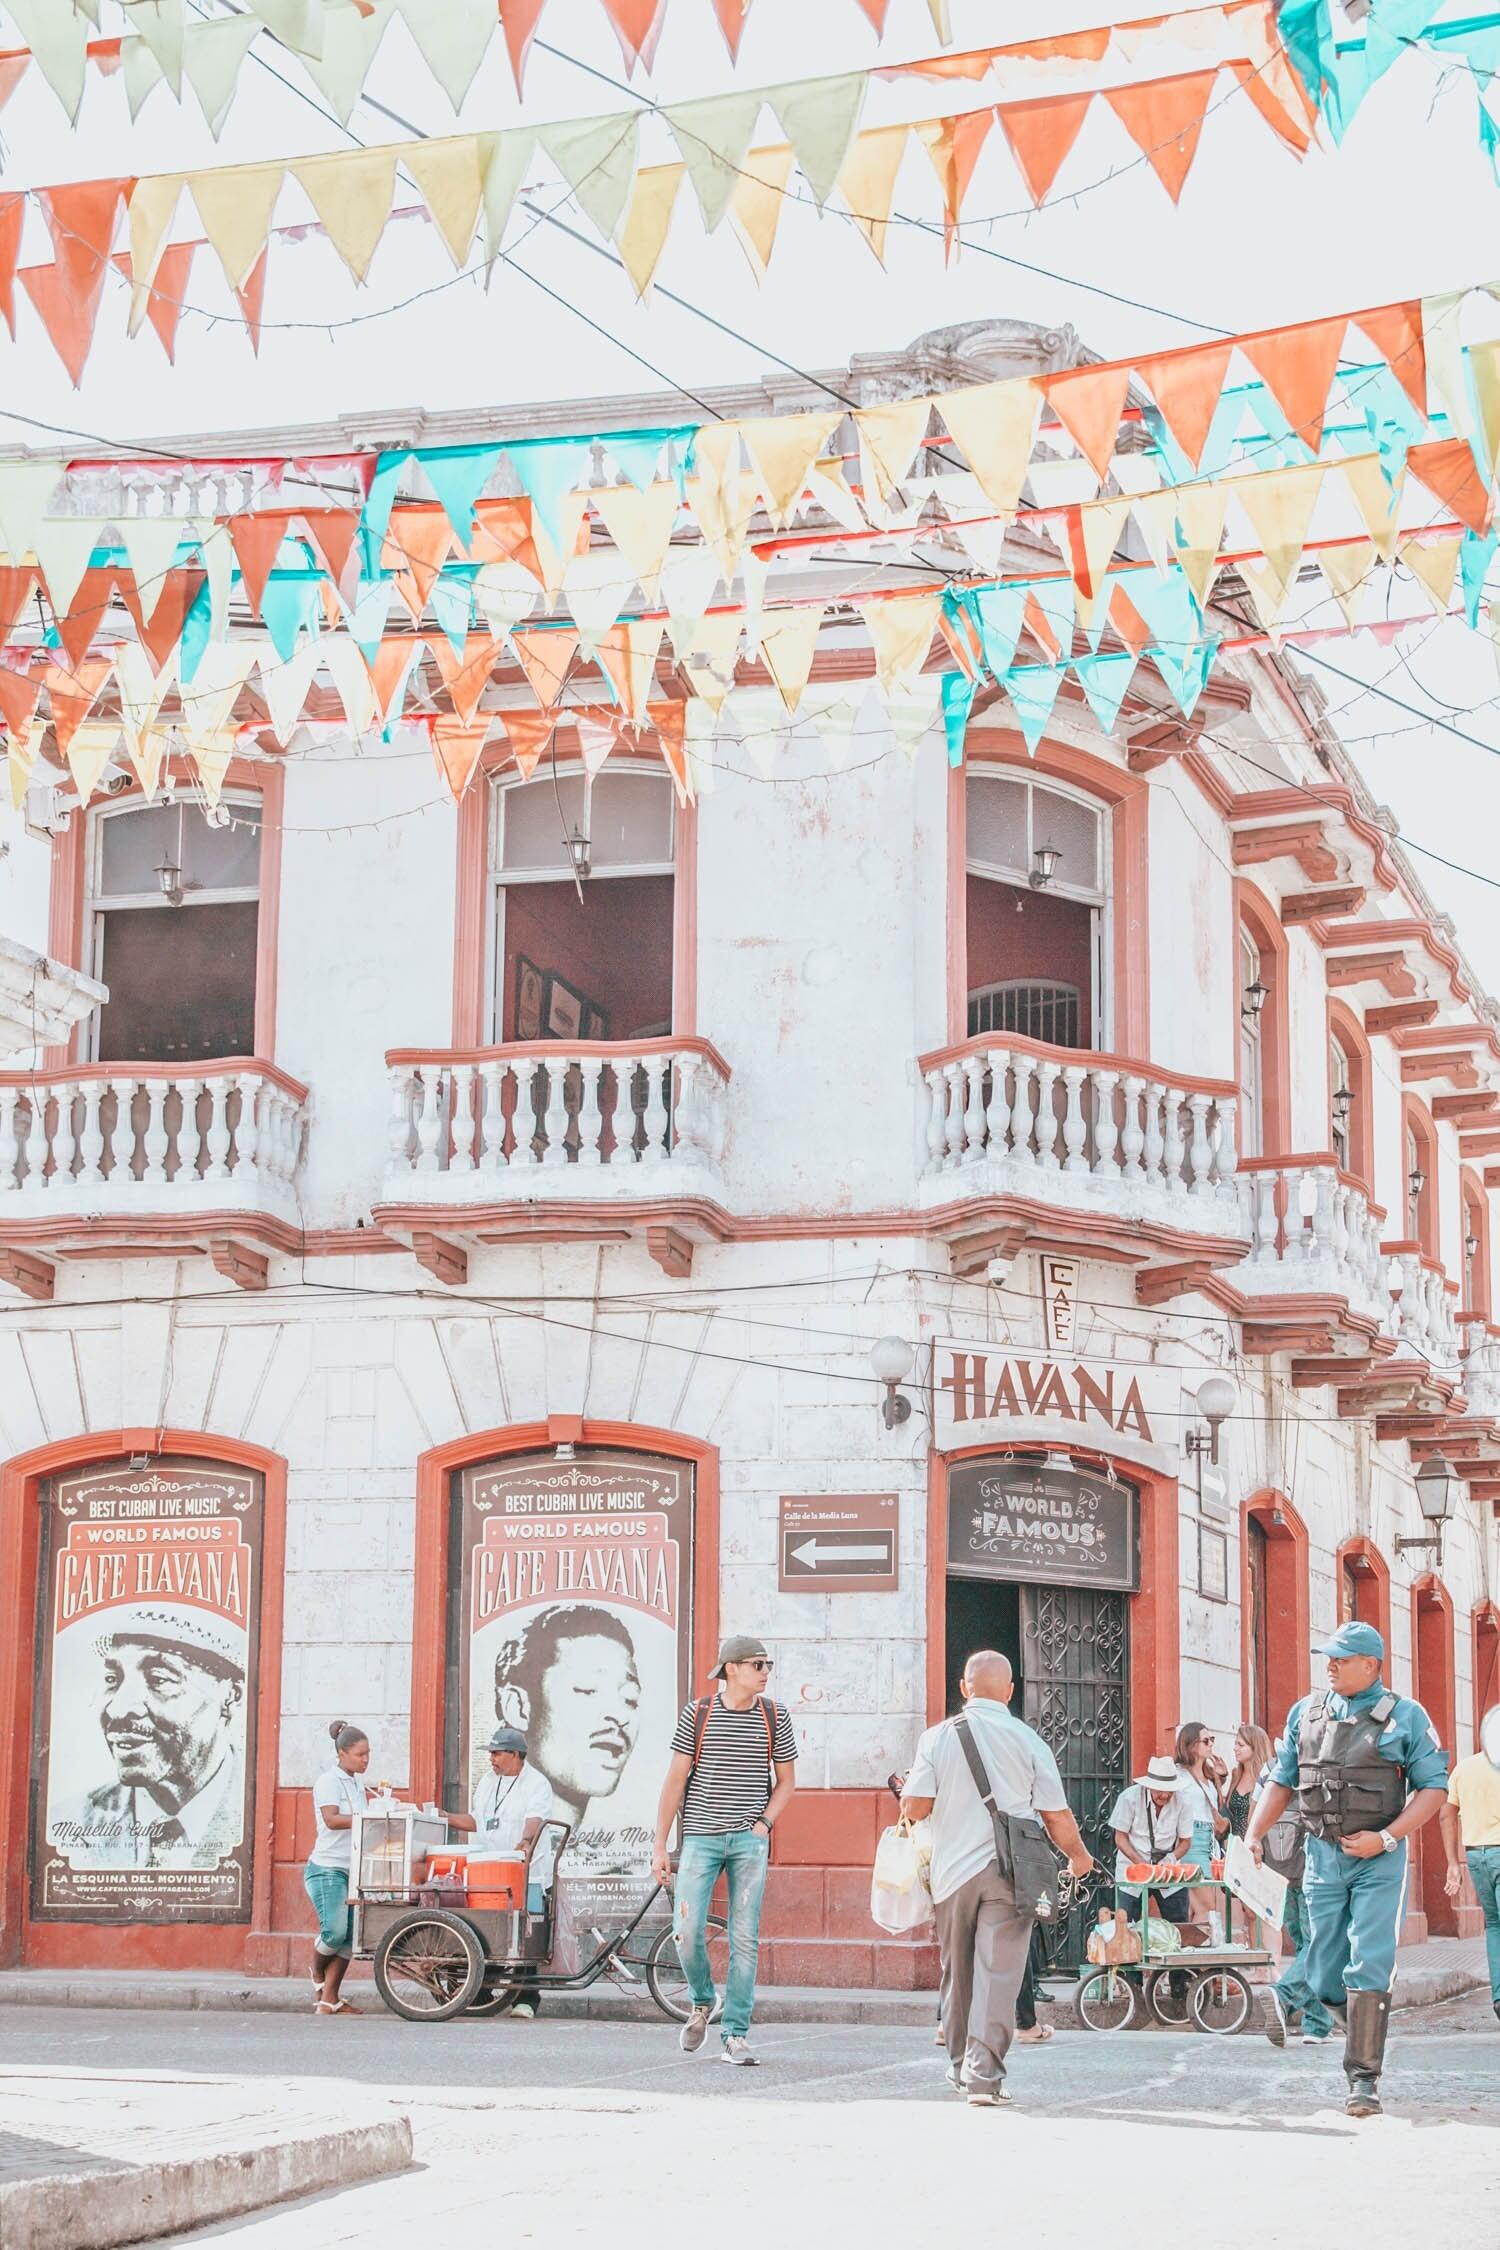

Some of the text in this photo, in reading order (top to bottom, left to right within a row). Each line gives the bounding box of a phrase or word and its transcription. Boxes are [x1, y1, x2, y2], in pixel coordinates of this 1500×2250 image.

[941, 1352, 1153, 1443] HAVANA
[90, 1498, 221, 1518] BEST CUBAN LIVE MUSIC
[505, 1491, 645, 1512] BEST CUBAN LIVE MUSIC
[1005, 1495, 1073, 1518] WORLD
[784, 1511, 858, 1520] Calle de la Media Luna
[87, 1526, 222, 1543] WORLD FAMOUS
[504, 1521, 647, 1539] WORLD FAMOUS
[982, 1511, 1096, 1546] FAMOUS
[62, 1552, 243, 1619] CAFE HAVANA
[479, 1548, 672, 1618] CAFE HAVANA
[52, 1821, 122, 1842] Miguelito
[620, 1826, 656, 1847] Mor
[52, 1875, 235, 1884] LA ESQUINA DEL MOVIMIENTO
[564, 1883, 653, 1891] EL MOVIMIEN
